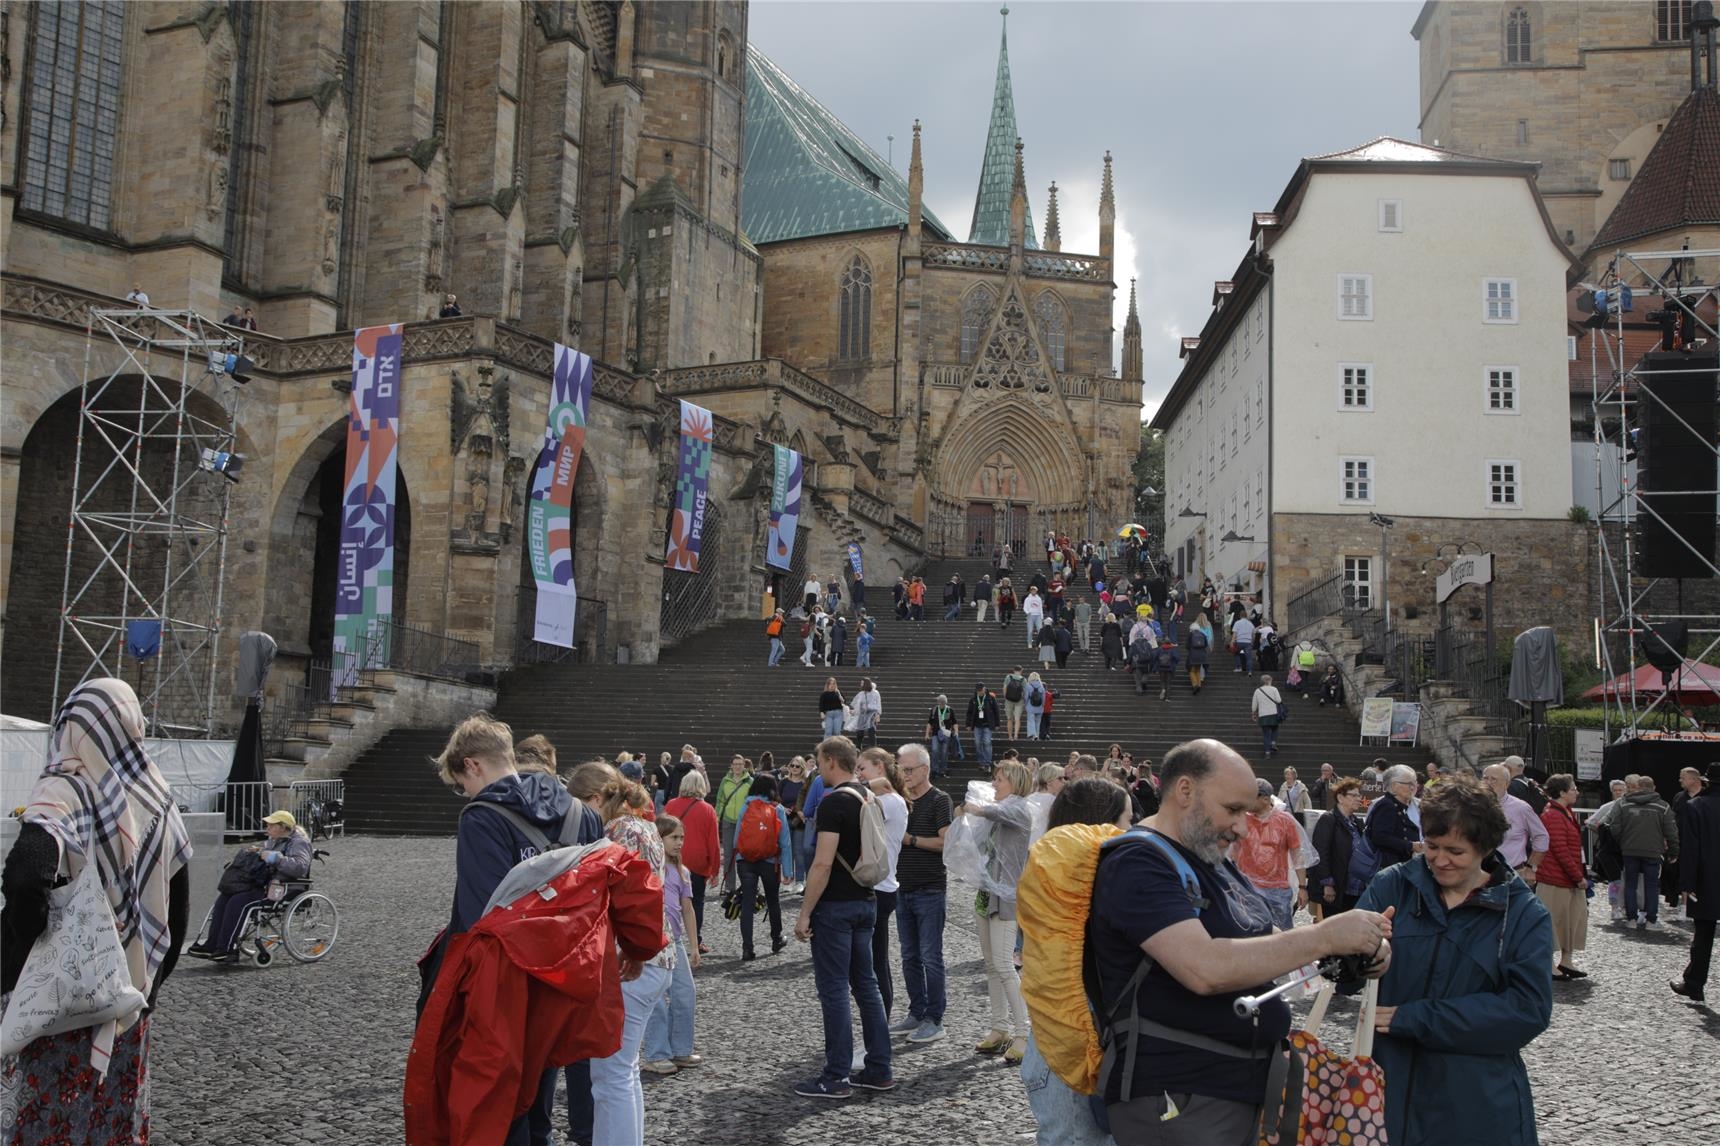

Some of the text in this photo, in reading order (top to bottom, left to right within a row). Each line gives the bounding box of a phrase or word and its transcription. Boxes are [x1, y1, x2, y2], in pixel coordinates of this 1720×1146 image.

[377, 355, 394, 398] אדם
[557, 446, 575, 486] МИР
[692, 489, 707, 540] PEACE
[533, 505, 547, 576] FRIEDEN
[339, 541, 364, 600] إنسان
